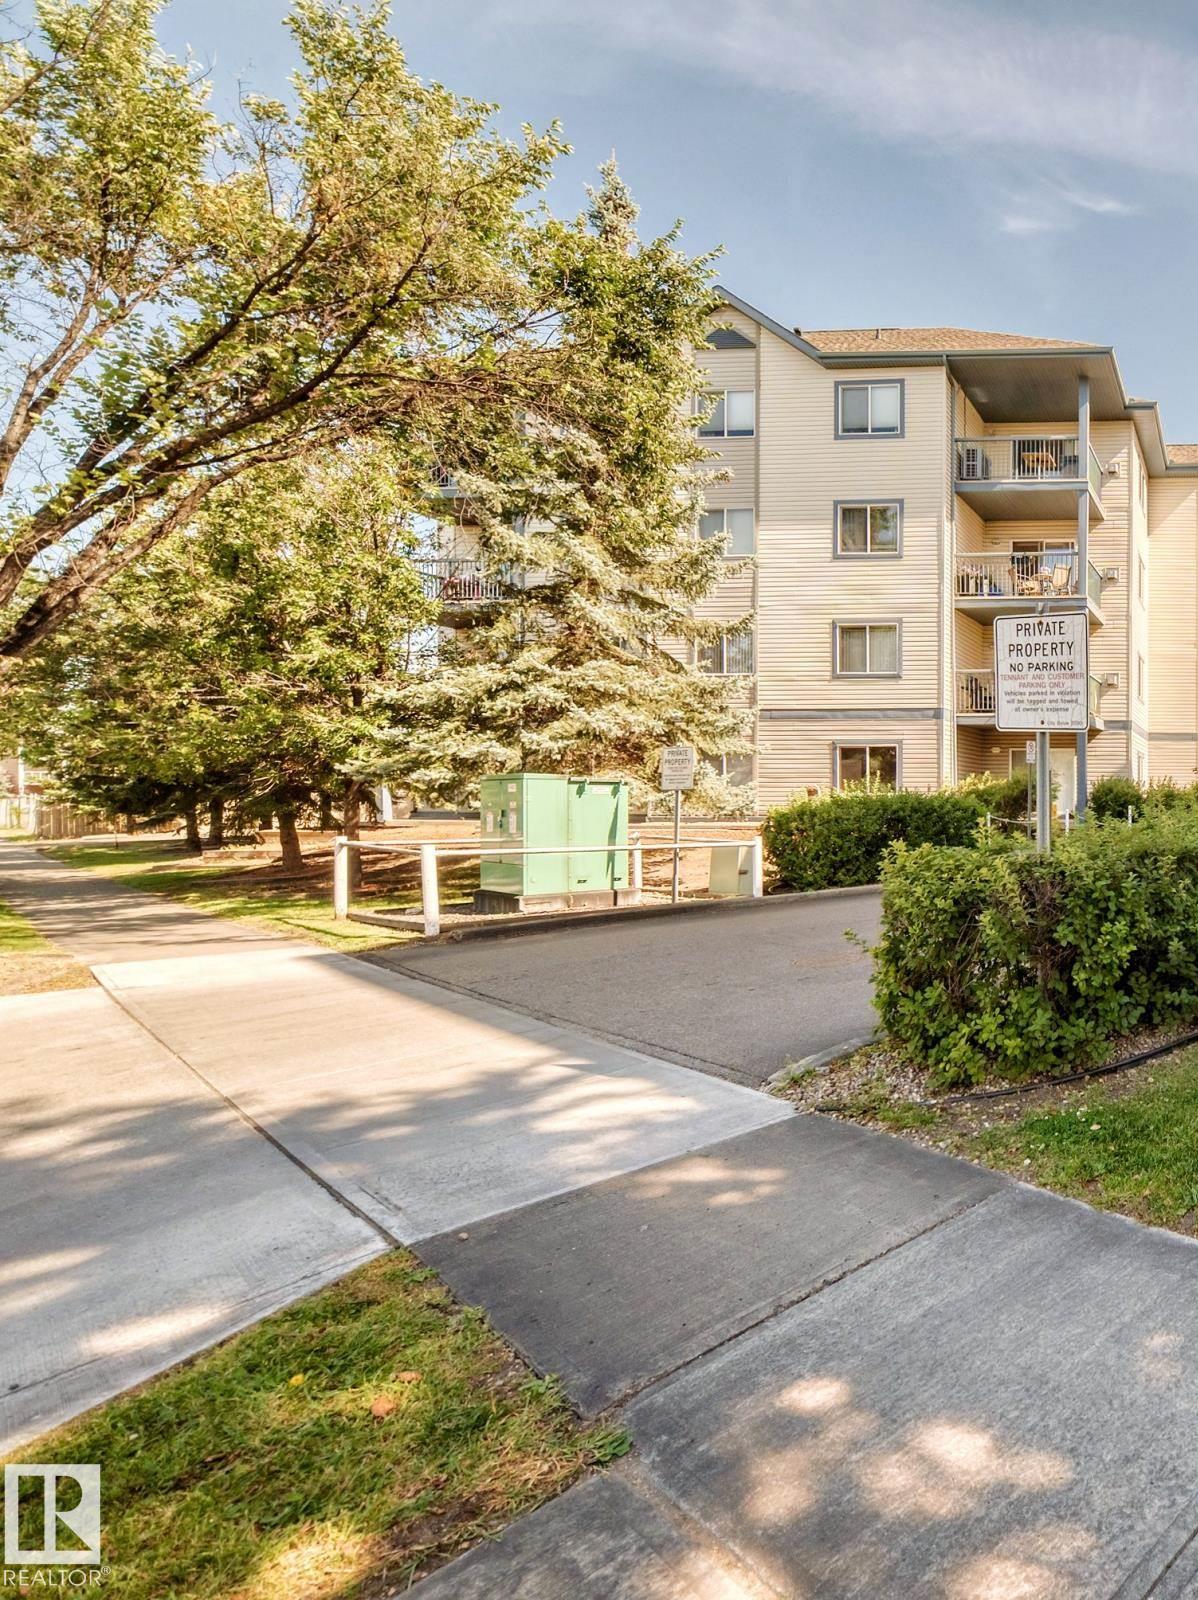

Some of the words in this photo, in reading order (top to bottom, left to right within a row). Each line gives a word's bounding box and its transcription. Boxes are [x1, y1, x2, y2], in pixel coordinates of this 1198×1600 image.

[1016, 621, 1065, 637] PRIVATE
[1008, 641, 1074, 658] PROPERTY
[1009, 662, 1024, 672] NO
[1028, 661, 1074, 672] PARKING
[1048, 672, 1085, 680] CUSTOMER
[667, 749, 689, 757] PRIVATE
